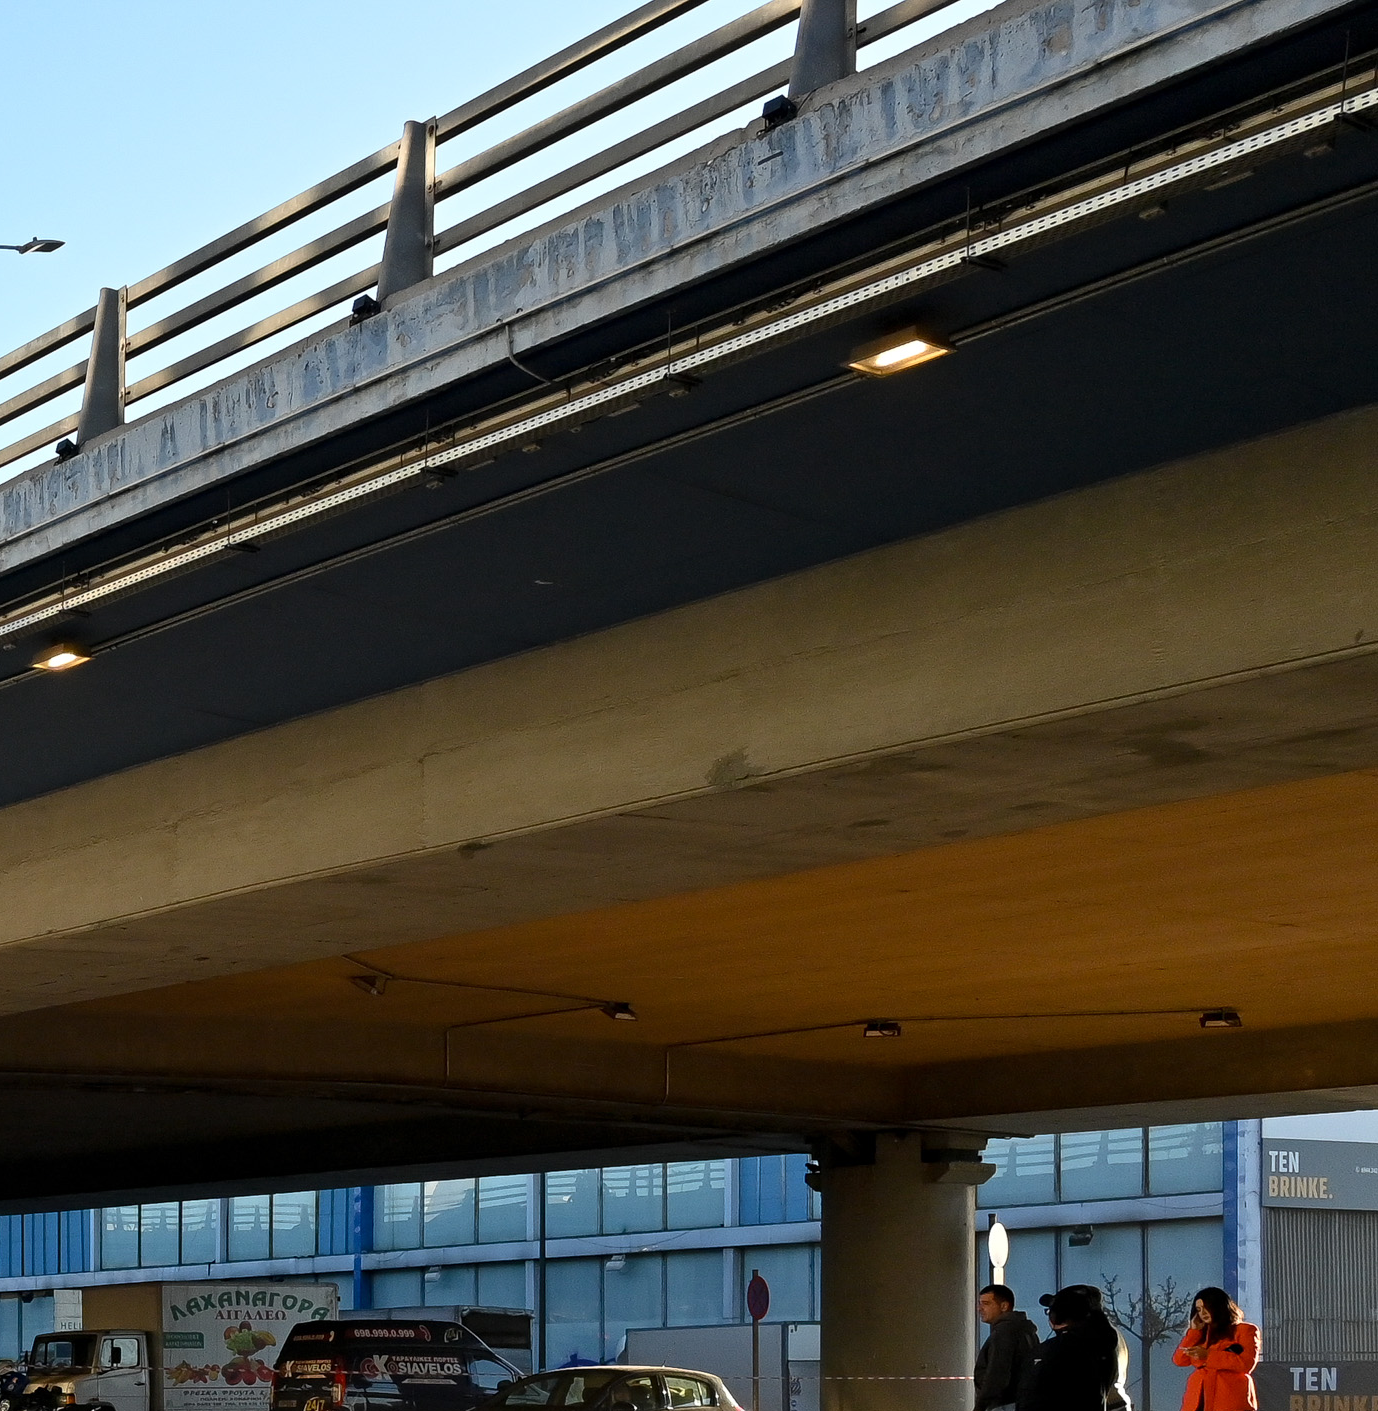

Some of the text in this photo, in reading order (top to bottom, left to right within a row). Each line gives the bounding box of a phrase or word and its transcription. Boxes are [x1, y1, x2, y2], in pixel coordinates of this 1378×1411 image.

[1268, 1151, 1300, 1173] TEN
[1268, 1176, 1334, 1199] BRINKE.
[170, 1290, 330, 1321] ΛΑΧΑΝΑΓΟΡΑ
[215, 1310, 287, 1321] ΑΙΓΑΛΕΩ
[354, 1329, 415, 1338] 698.999.0.999
[1290, 1367, 1337, 1391] TEN
